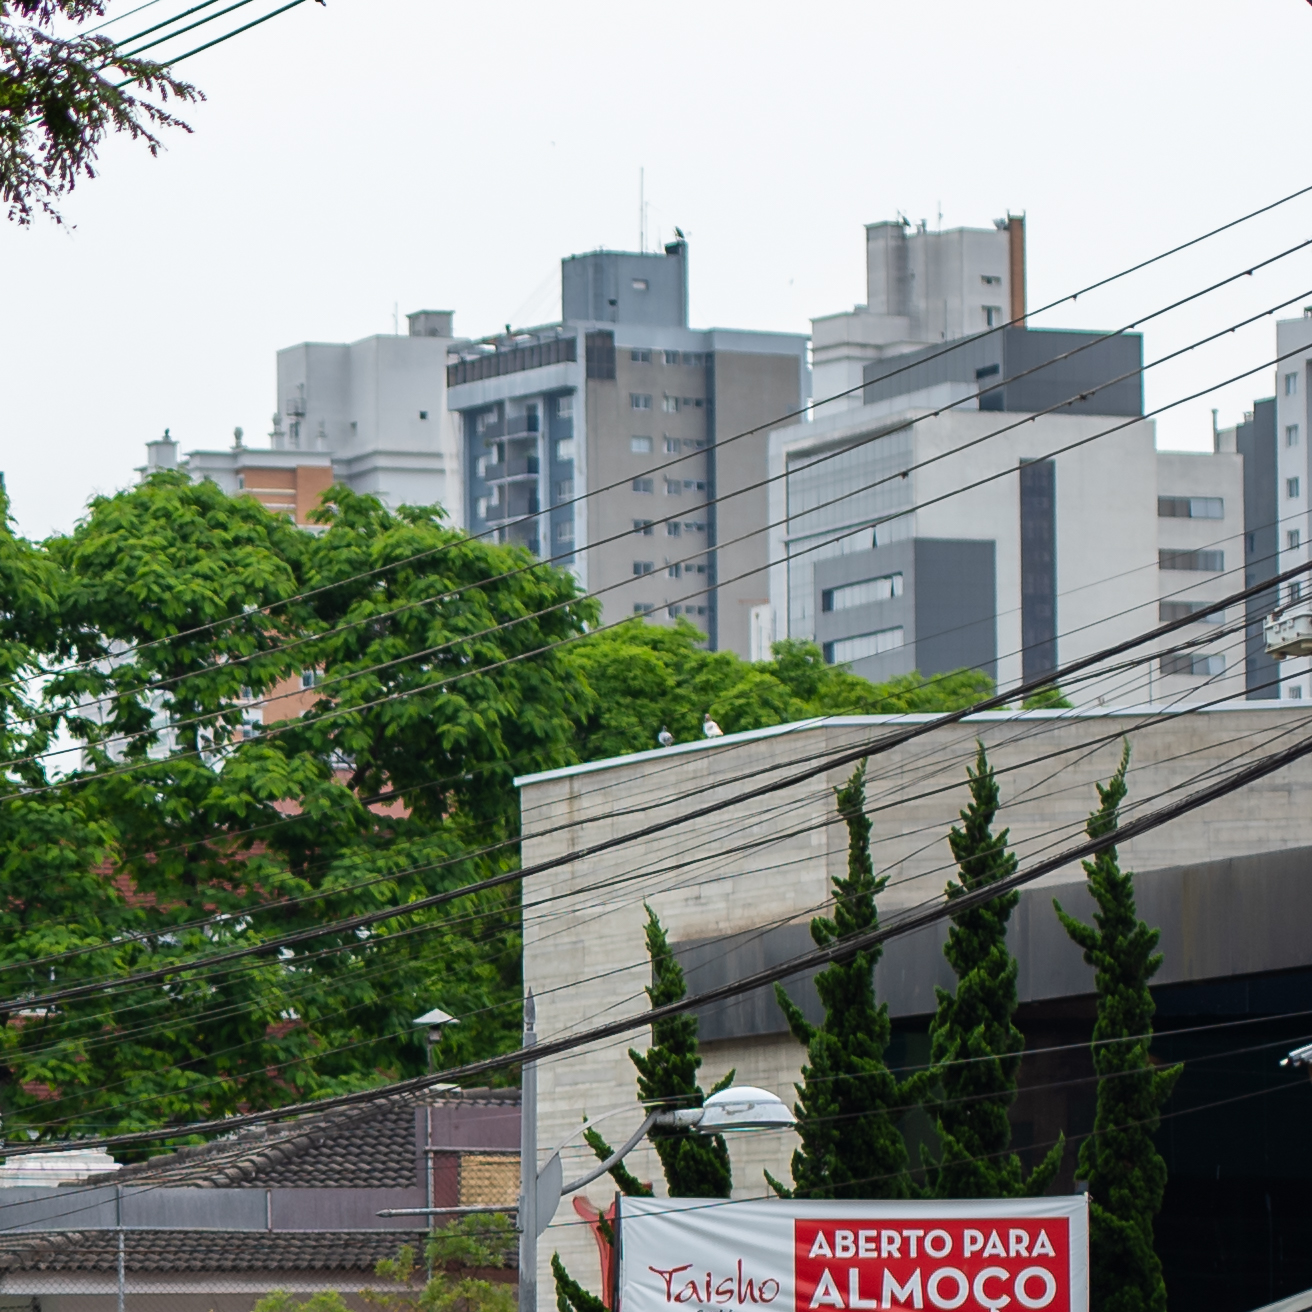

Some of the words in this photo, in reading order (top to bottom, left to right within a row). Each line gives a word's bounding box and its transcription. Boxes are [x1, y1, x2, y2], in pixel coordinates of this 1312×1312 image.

[808, 1229, 953, 1259] ABERTO
[963, 1228, 1057, 1259] PARA
[648, 1258, 780, 1304] Taisho
